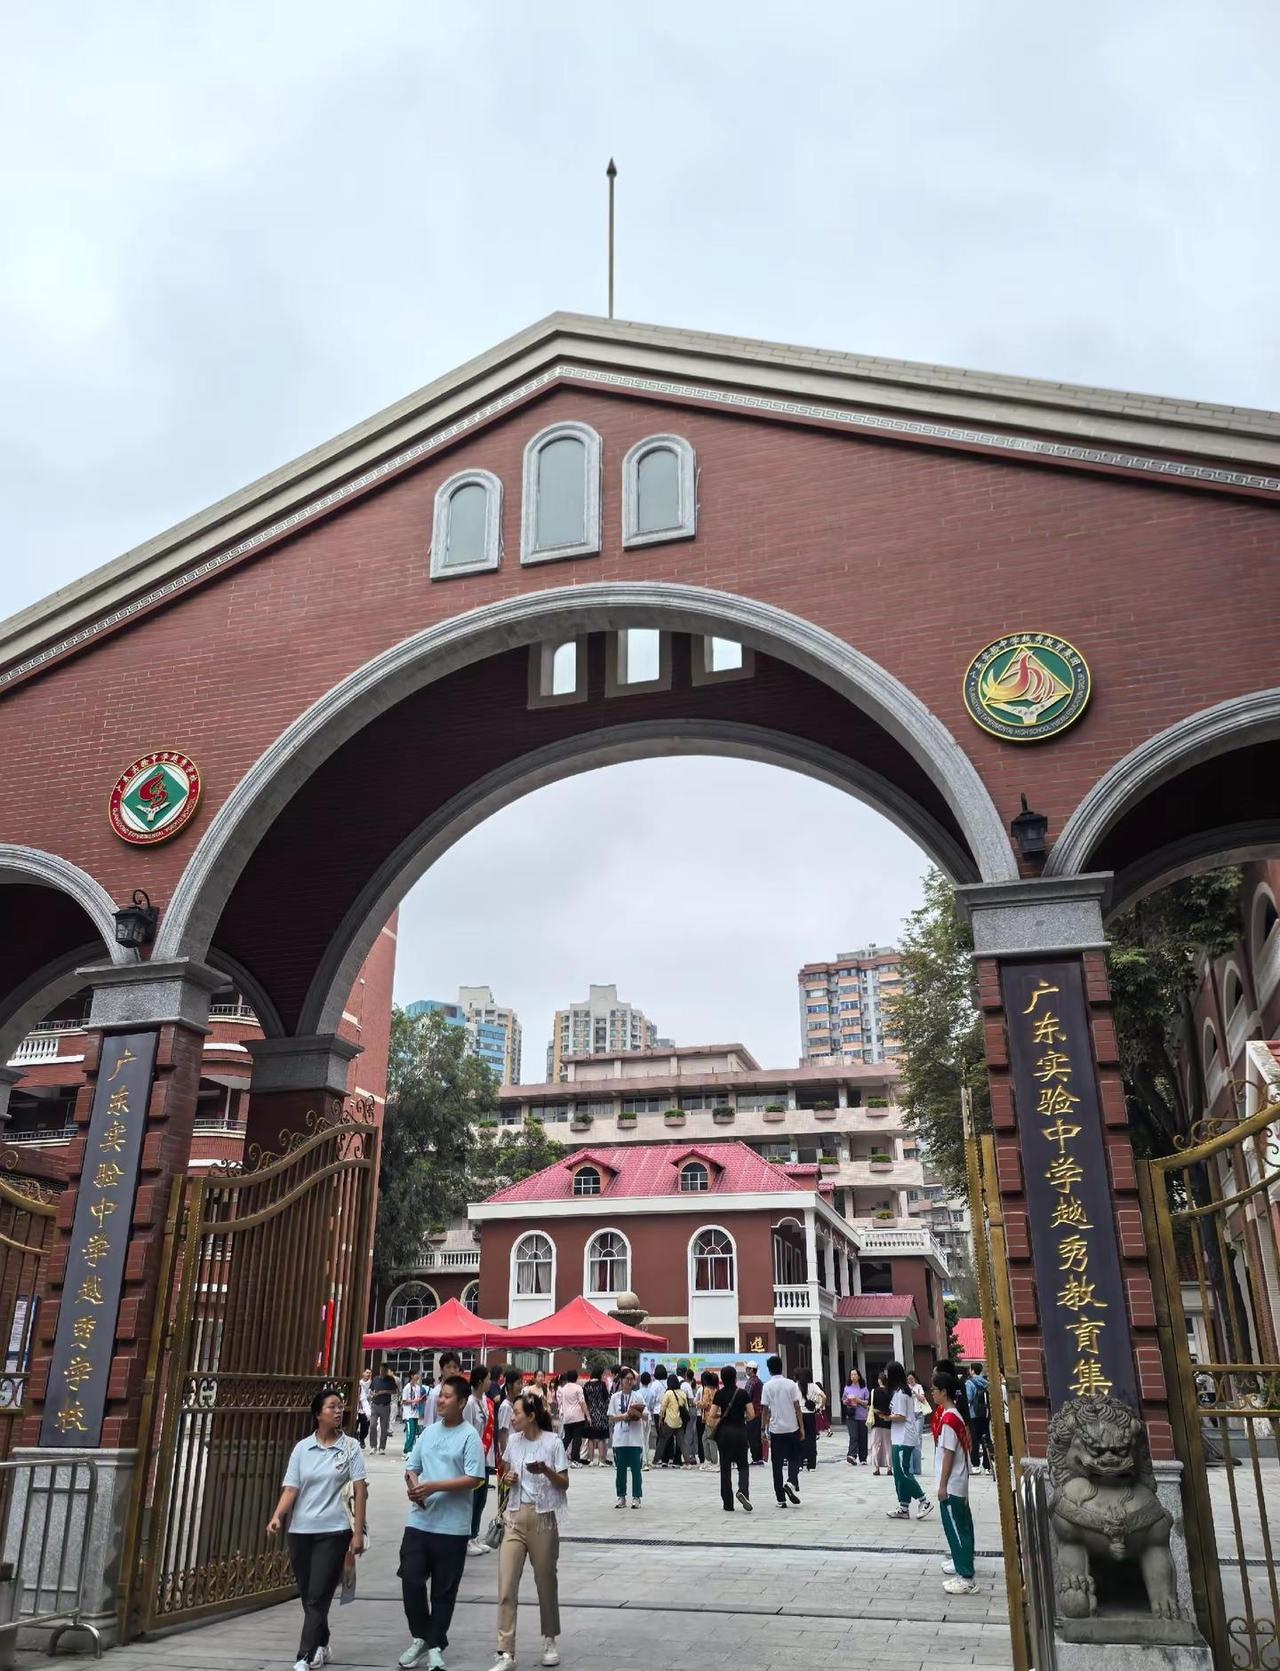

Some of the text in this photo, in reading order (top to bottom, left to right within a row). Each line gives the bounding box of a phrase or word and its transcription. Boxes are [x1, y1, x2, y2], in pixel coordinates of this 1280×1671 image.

[55, 1048, 137, 1433] 广东实验中学越秀学校
[1022, 978, 1113, 1397] 广东实验中学越秀教育集
